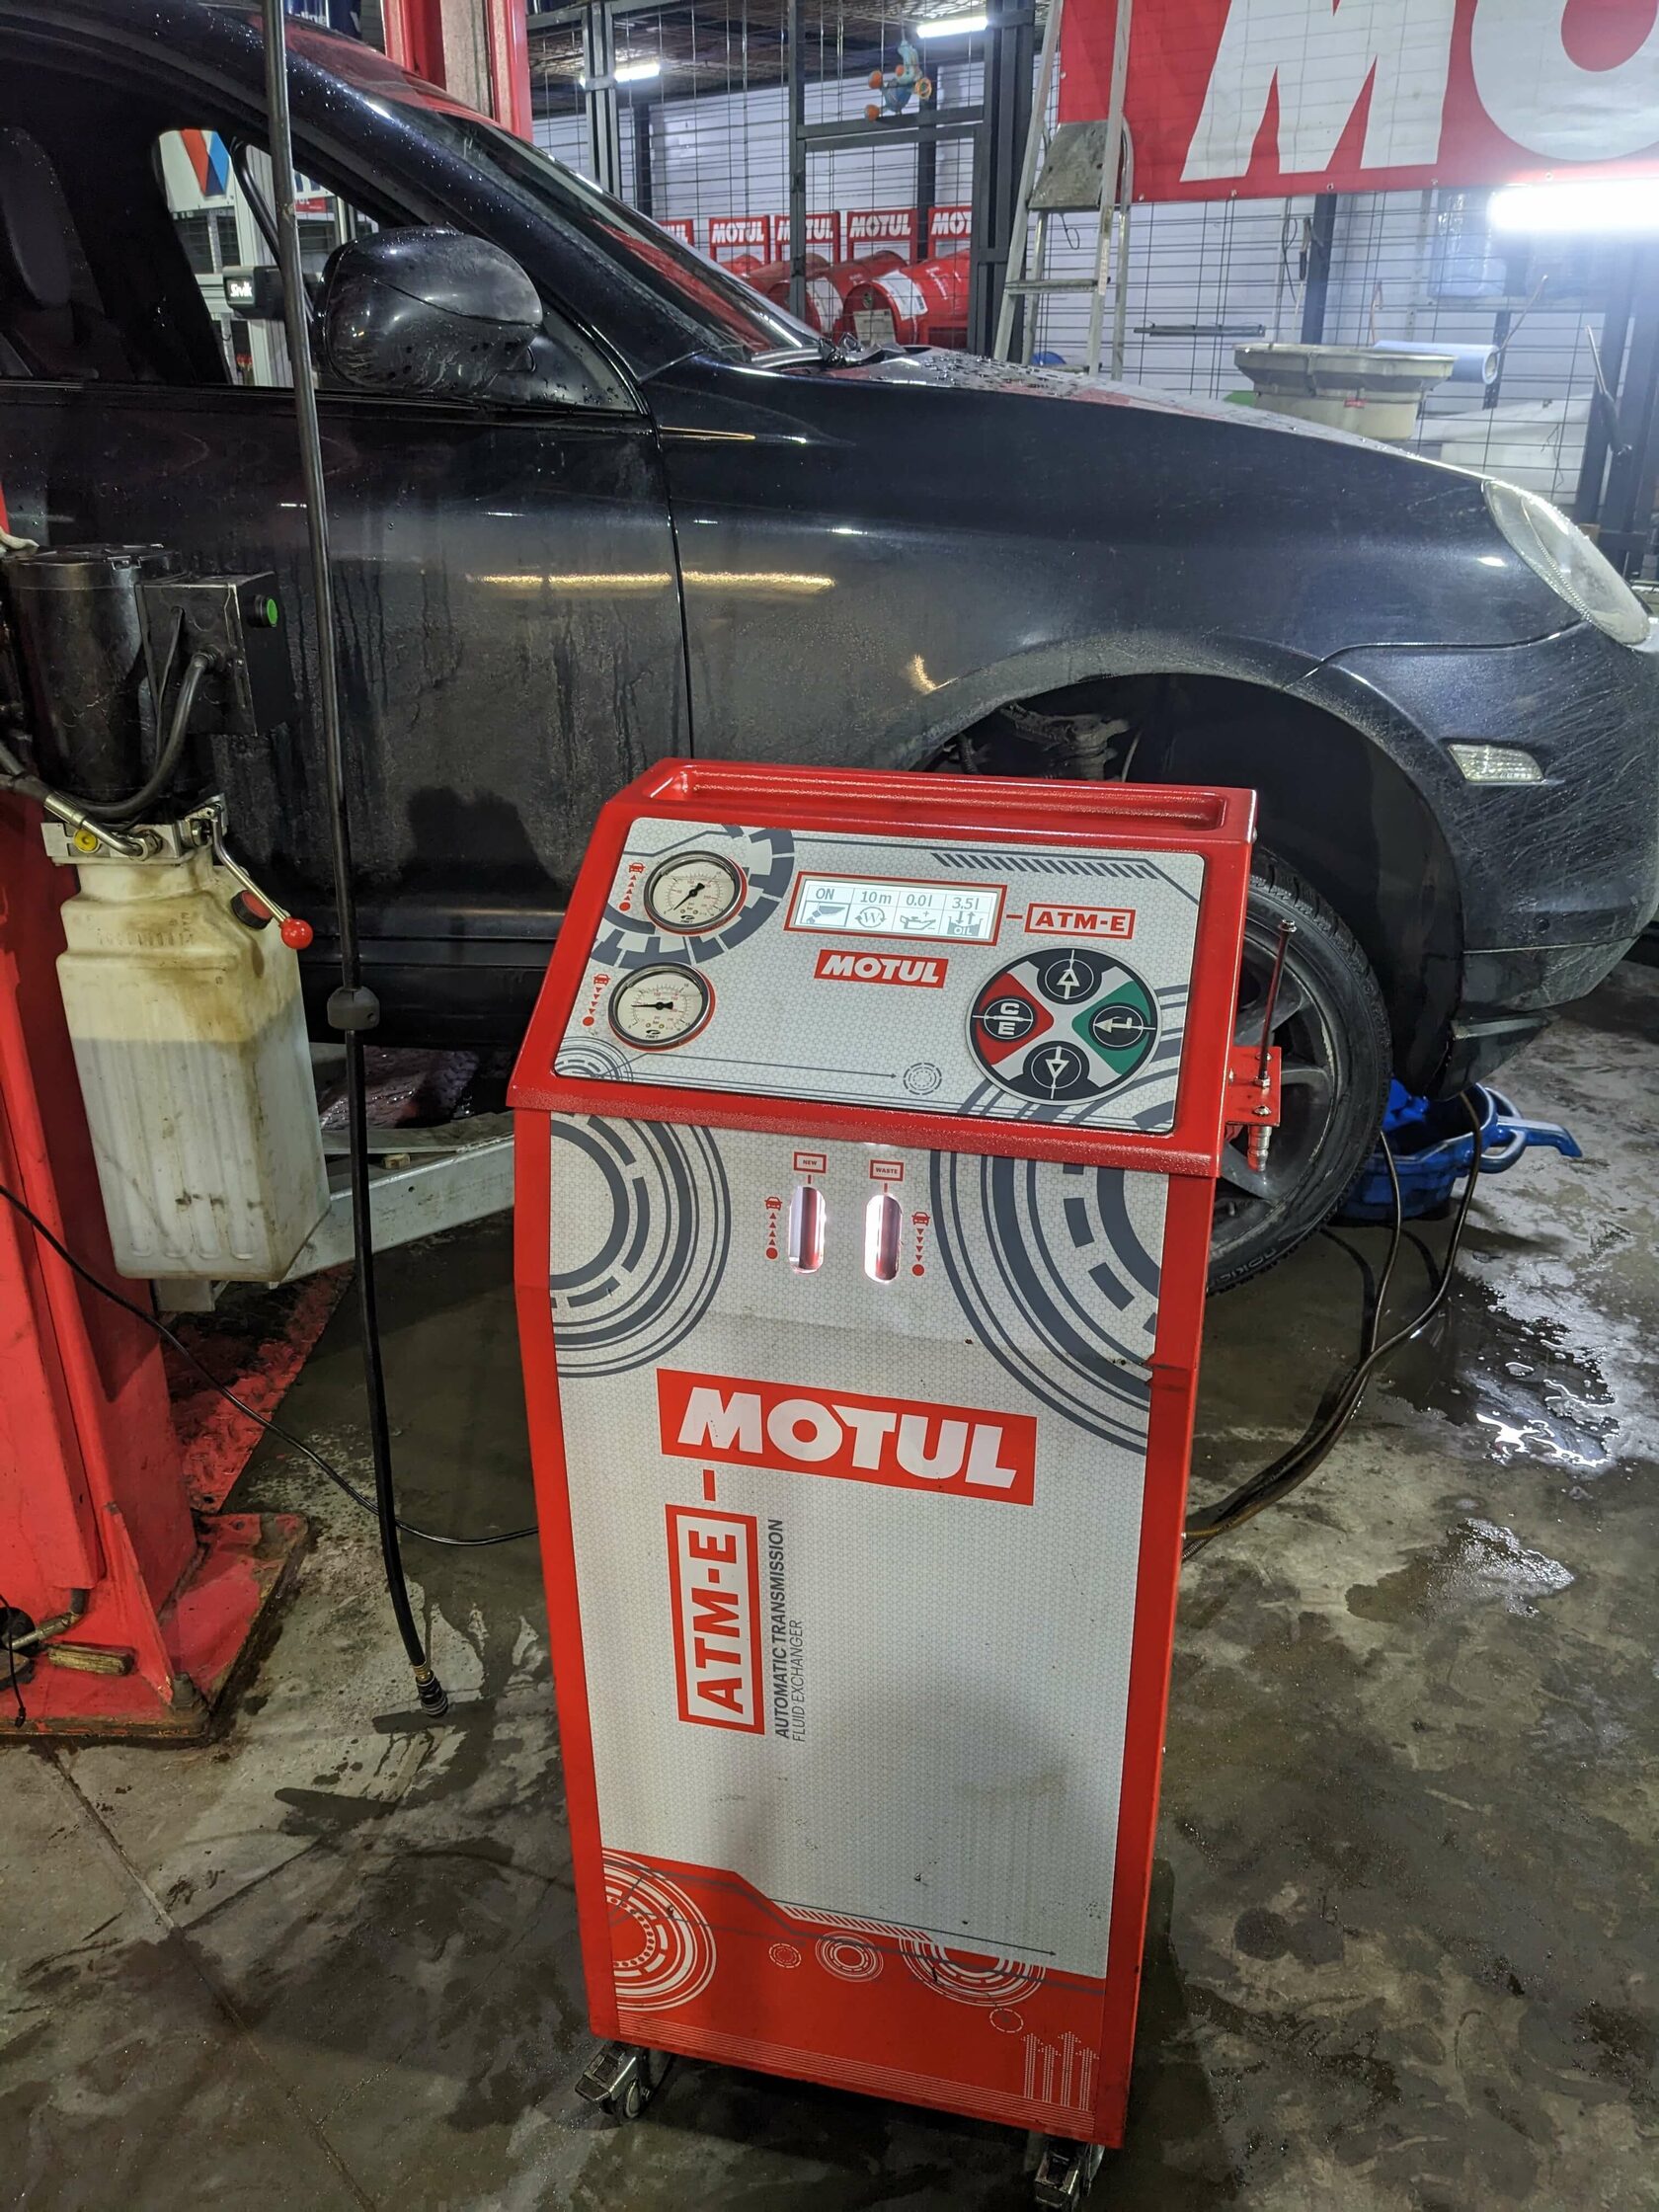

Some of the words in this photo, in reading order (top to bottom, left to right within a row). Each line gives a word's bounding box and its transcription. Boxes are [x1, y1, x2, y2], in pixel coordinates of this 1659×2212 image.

[711, 221, 764, 244] MOTUL
[774, 217, 833, 241] MTUL
[849, 213, 911, 238] MOTUL
[931, 210, 972, 235] MOT
[816, 888, 835, 900] ON
[954, 926, 973, 936] OIL
[1035, 910, 1126, 932] ATM-E
[821, 954, 940, 984] MOTUL
[999, 1002, 1020, 1015] C
[997, 1021, 1016, 1036] E
[875, 1166, 899, 1175] WASTE
[676, 1386, 1018, 1489] MOTUL
[769, 1520, 786, 1644] TRANSMISSION
[687, 1530, 744, 1715] ATM-E
[790, 1620, 805, 1700] EXCHANGER
[773, 1648, 789, 1738] AUTOMATIC
[792, 1705, 805, 1741] FLUID
